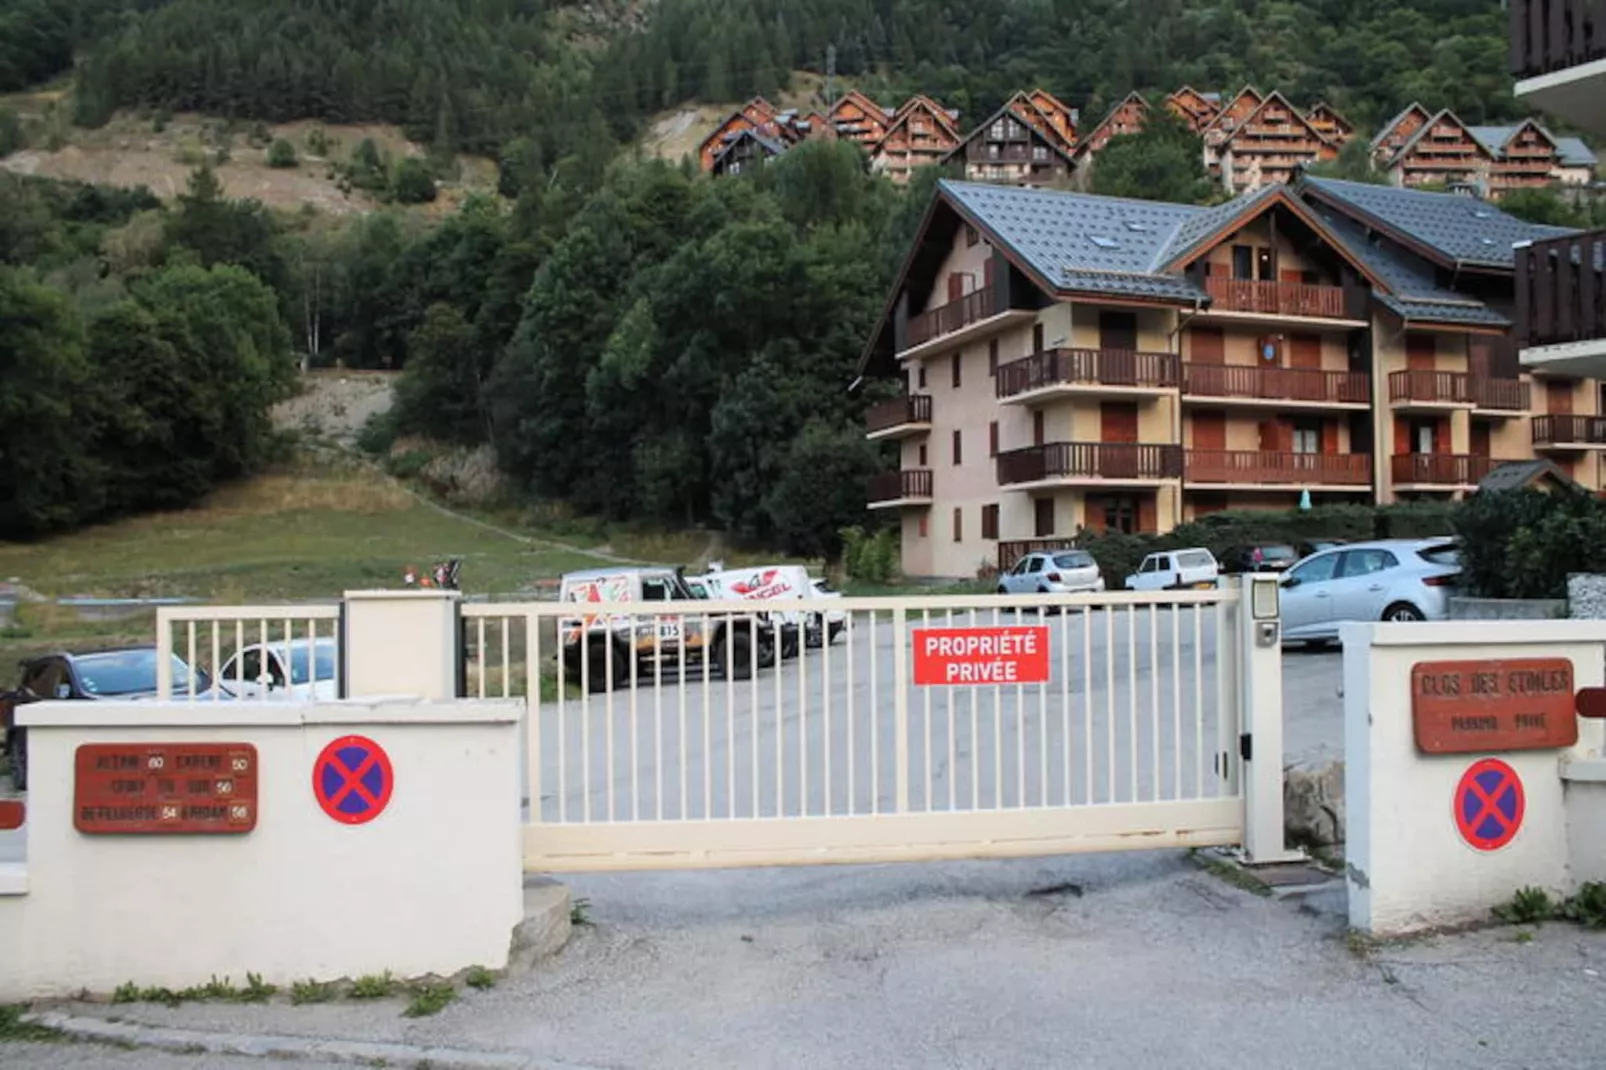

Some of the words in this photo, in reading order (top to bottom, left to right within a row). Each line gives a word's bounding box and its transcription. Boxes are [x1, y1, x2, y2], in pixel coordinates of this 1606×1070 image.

[925, 629, 1037, 656] PROPRIÉTÉ
[946, 656, 1017, 682] PRIVÉE
[1421, 674, 1460, 695] CLOS
